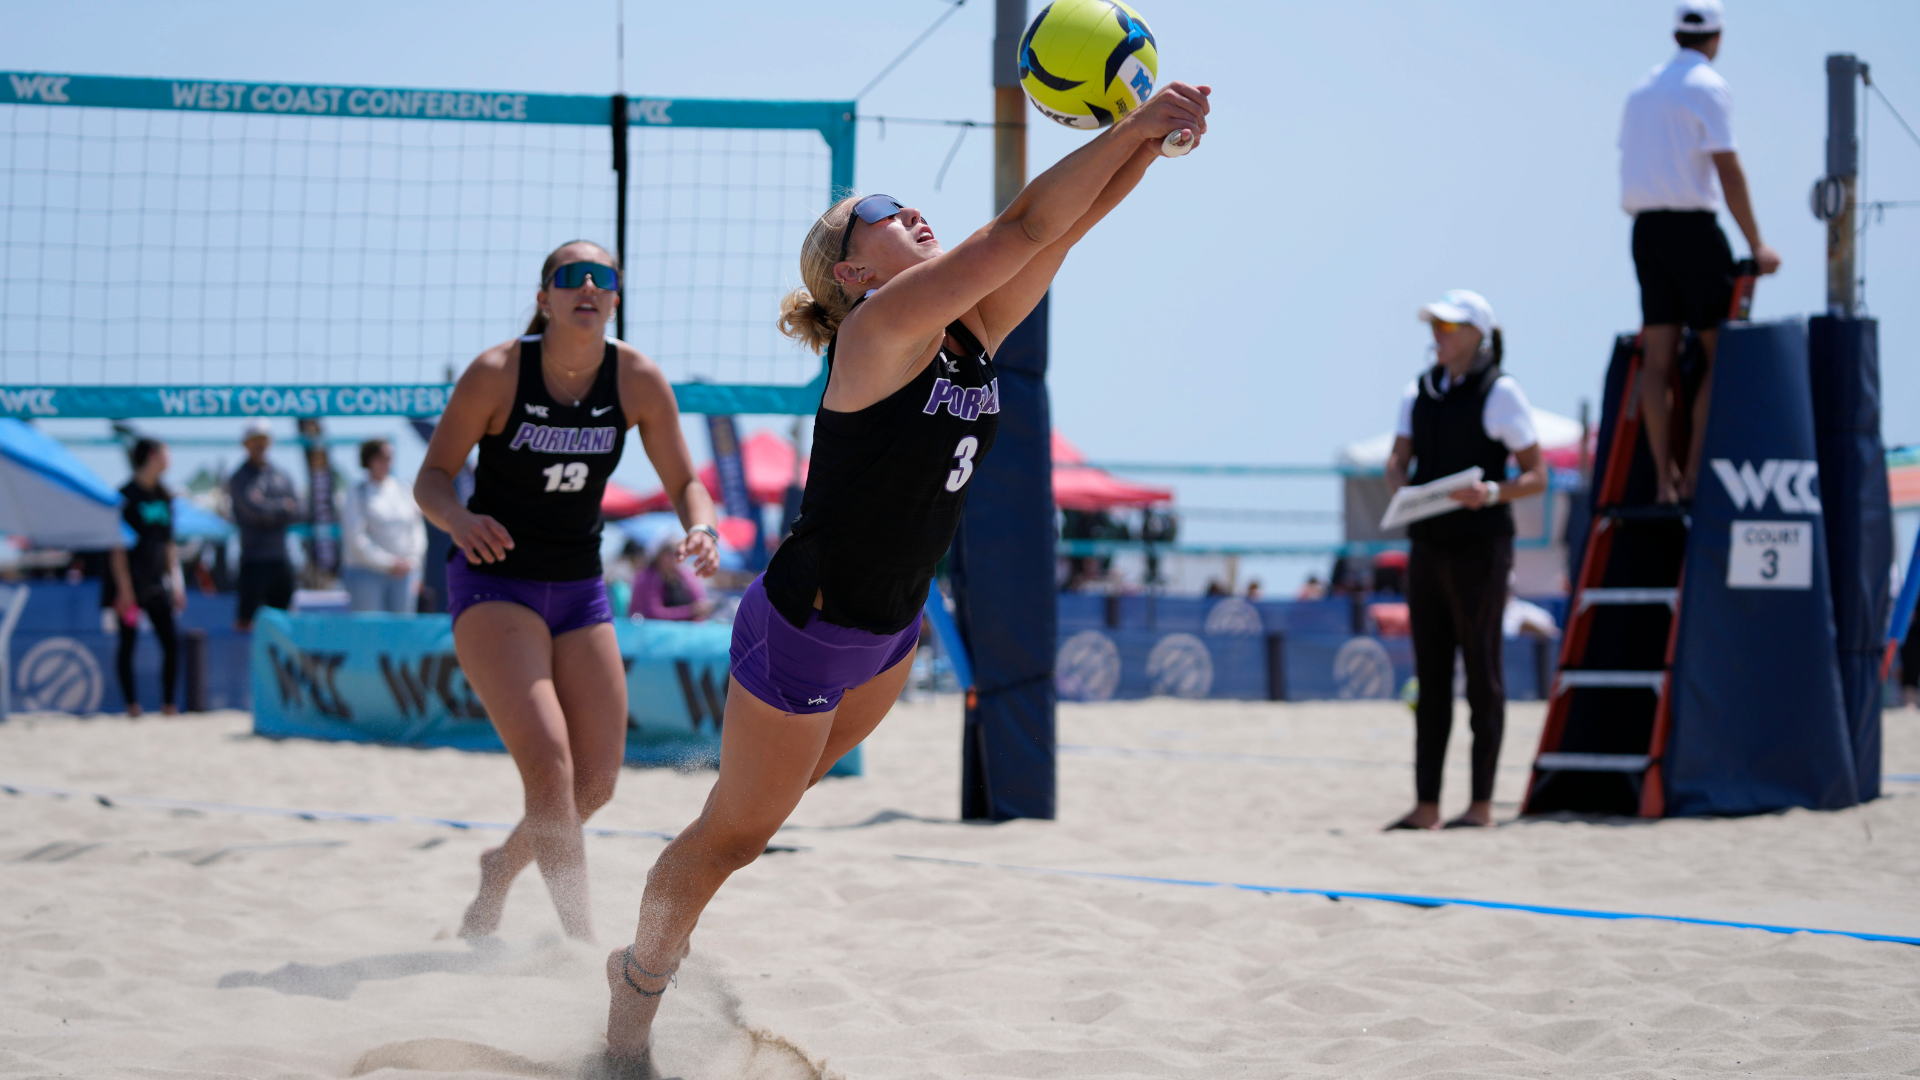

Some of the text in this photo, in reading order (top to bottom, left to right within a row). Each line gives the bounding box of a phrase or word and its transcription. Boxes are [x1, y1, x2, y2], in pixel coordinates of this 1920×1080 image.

[9, 73, 71, 103] WCC
[171, 81, 527, 121] WEST COAST CONFERENCE
[1130, 66, 1153, 104] CAA
[158, 385, 455, 415] WEST COAST CONFER
[508, 421, 617, 454] PORTLAND
[542, 461, 589, 492] 13
[945, 434, 979, 493] 3
[1710, 458, 1823, 515] WCC
[1744, 527, 1800, 545] COURT
[1760, 549, 1779, 580] 3
